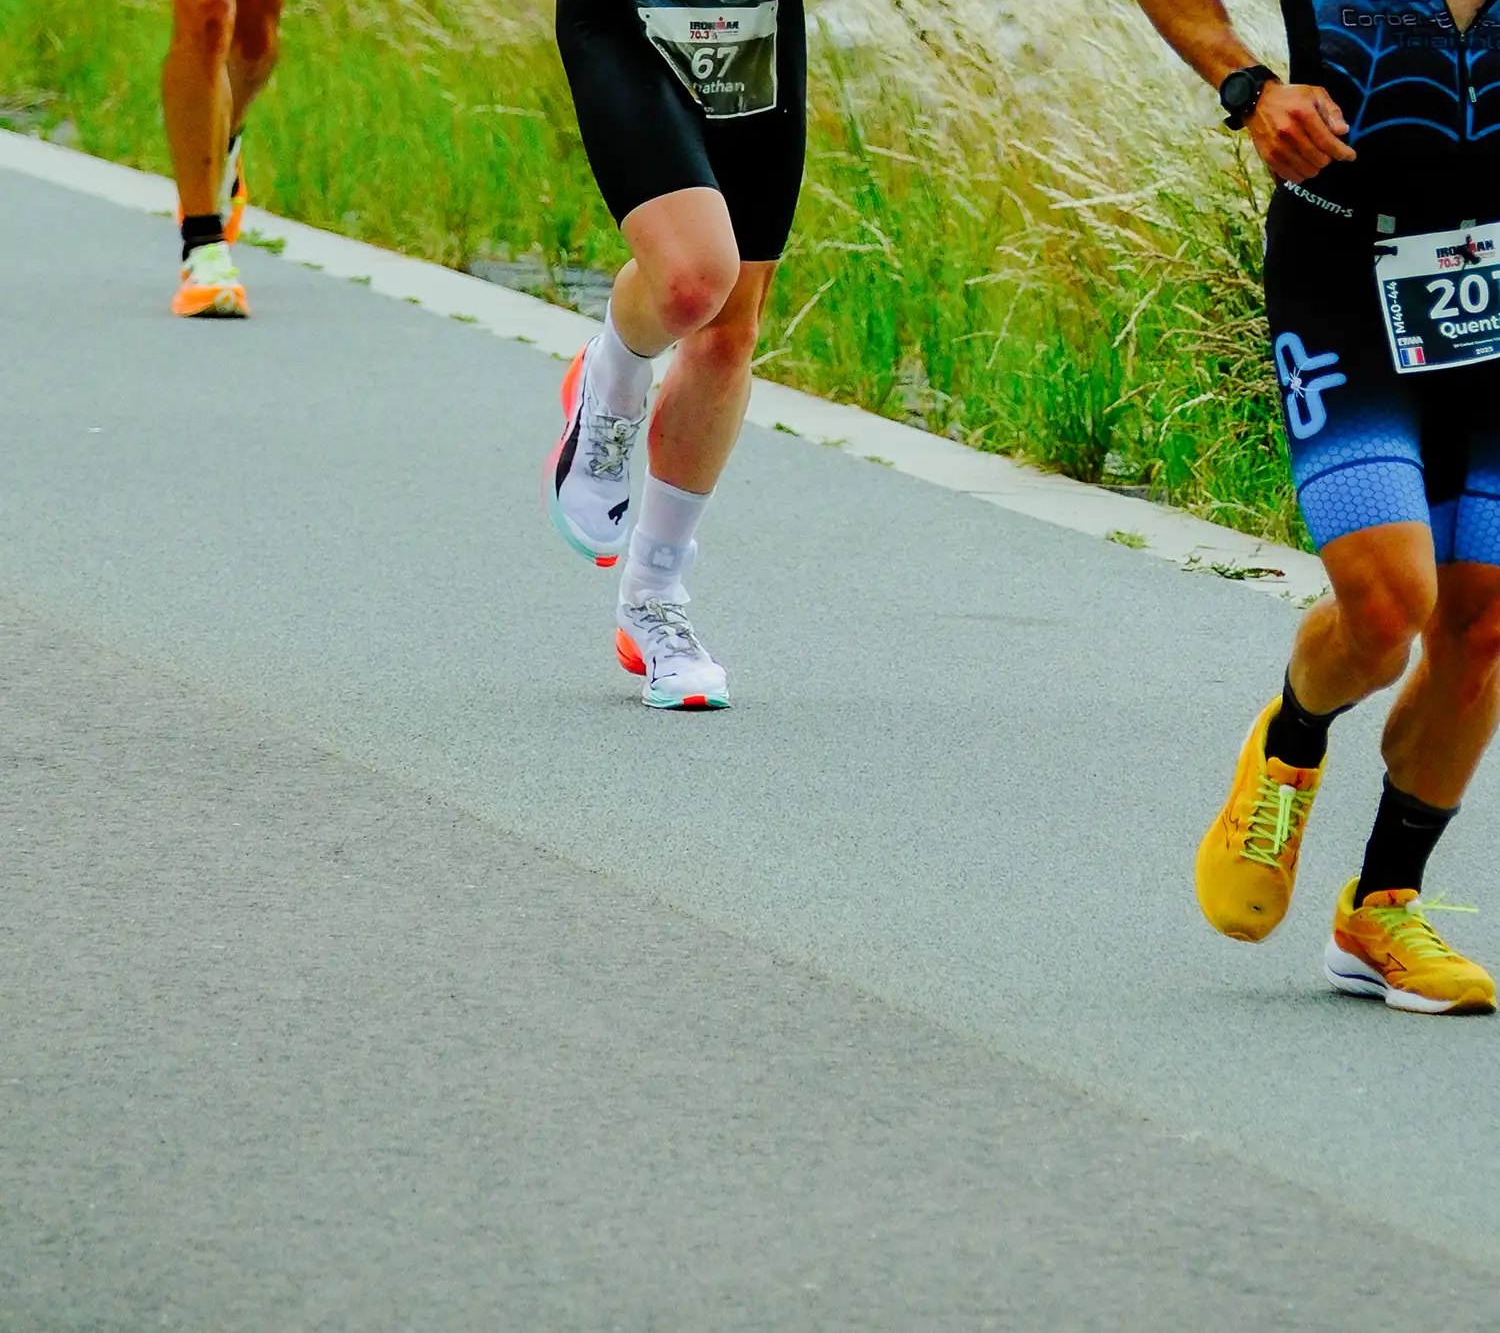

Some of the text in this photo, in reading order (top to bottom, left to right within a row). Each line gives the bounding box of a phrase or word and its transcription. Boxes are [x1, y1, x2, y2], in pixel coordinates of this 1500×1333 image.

[690, 19, 739, 30] IRONMAN
[690, 30, 710, 39] 70.3
[691, 46, 739, 80] 67
[1437, 256, 1461, 269] 70.3
[1386, 281, 1406, 334] M40-44
[1440, 312, 1500, 339] Quent
